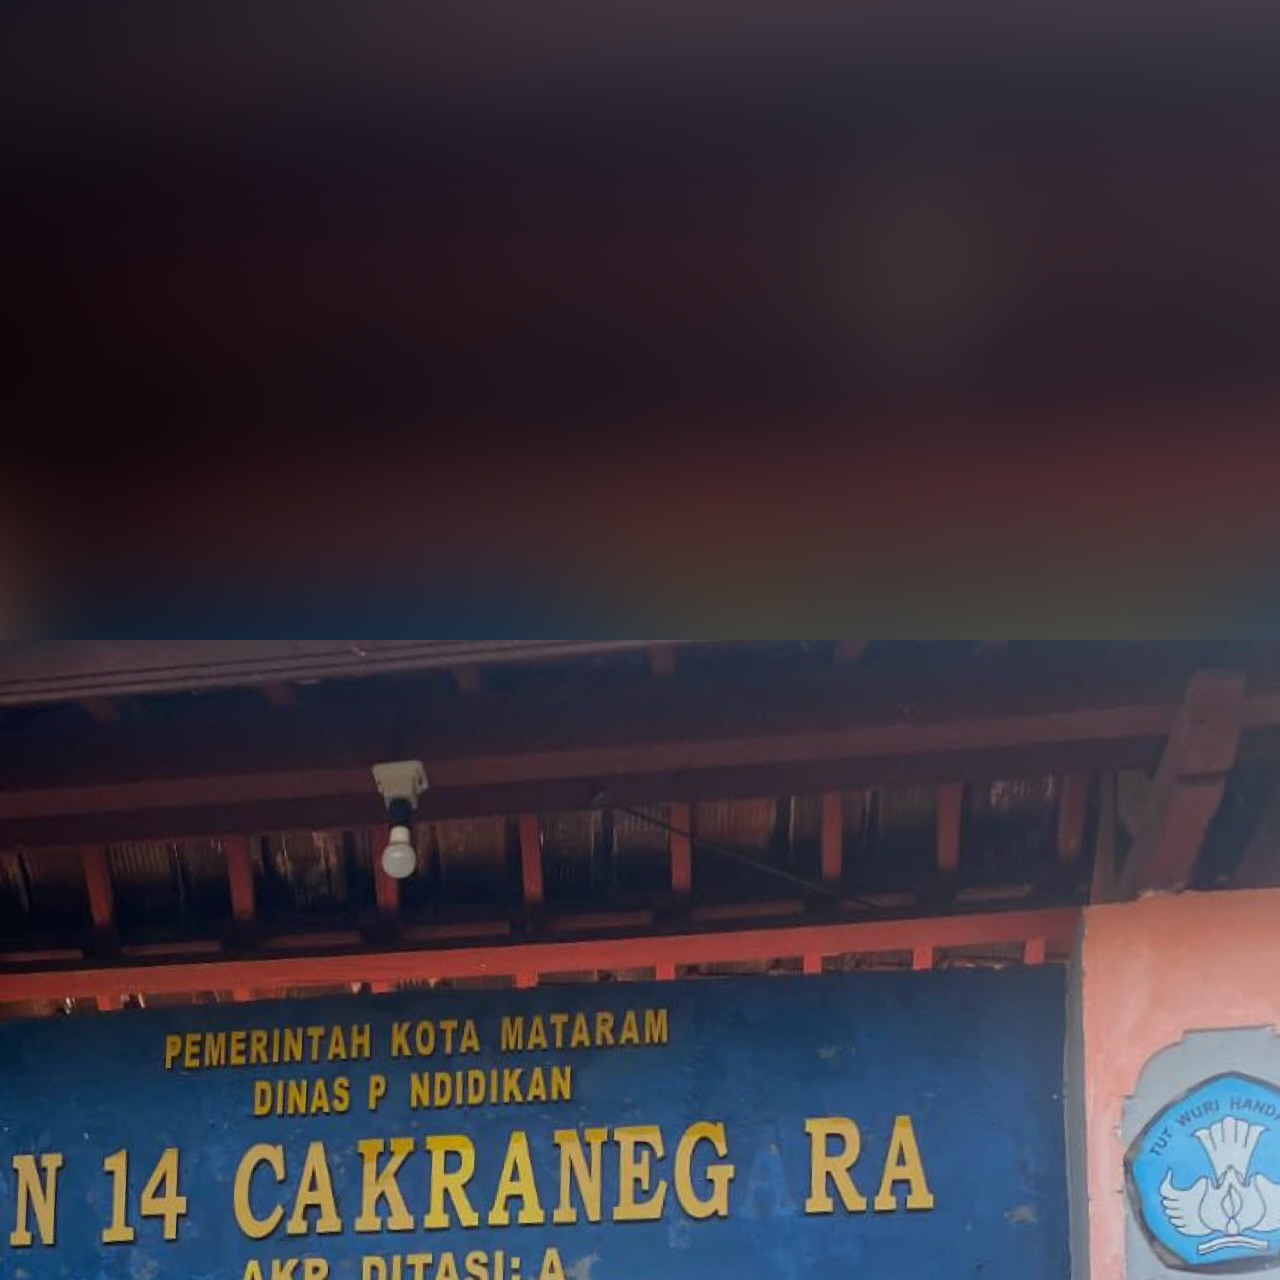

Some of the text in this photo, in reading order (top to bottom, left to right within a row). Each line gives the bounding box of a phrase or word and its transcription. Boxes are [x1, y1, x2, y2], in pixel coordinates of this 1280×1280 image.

[165, 1008, 669, 1069] PEMERINTAH KOTA MATARAM
[253, 1076, 350, 1117] DINAS
[1149, 1126, 1172, 1156] TUT
[1175, 1099, 1220, 1127] WURI
[101, 1147, 187, 1244] 14
